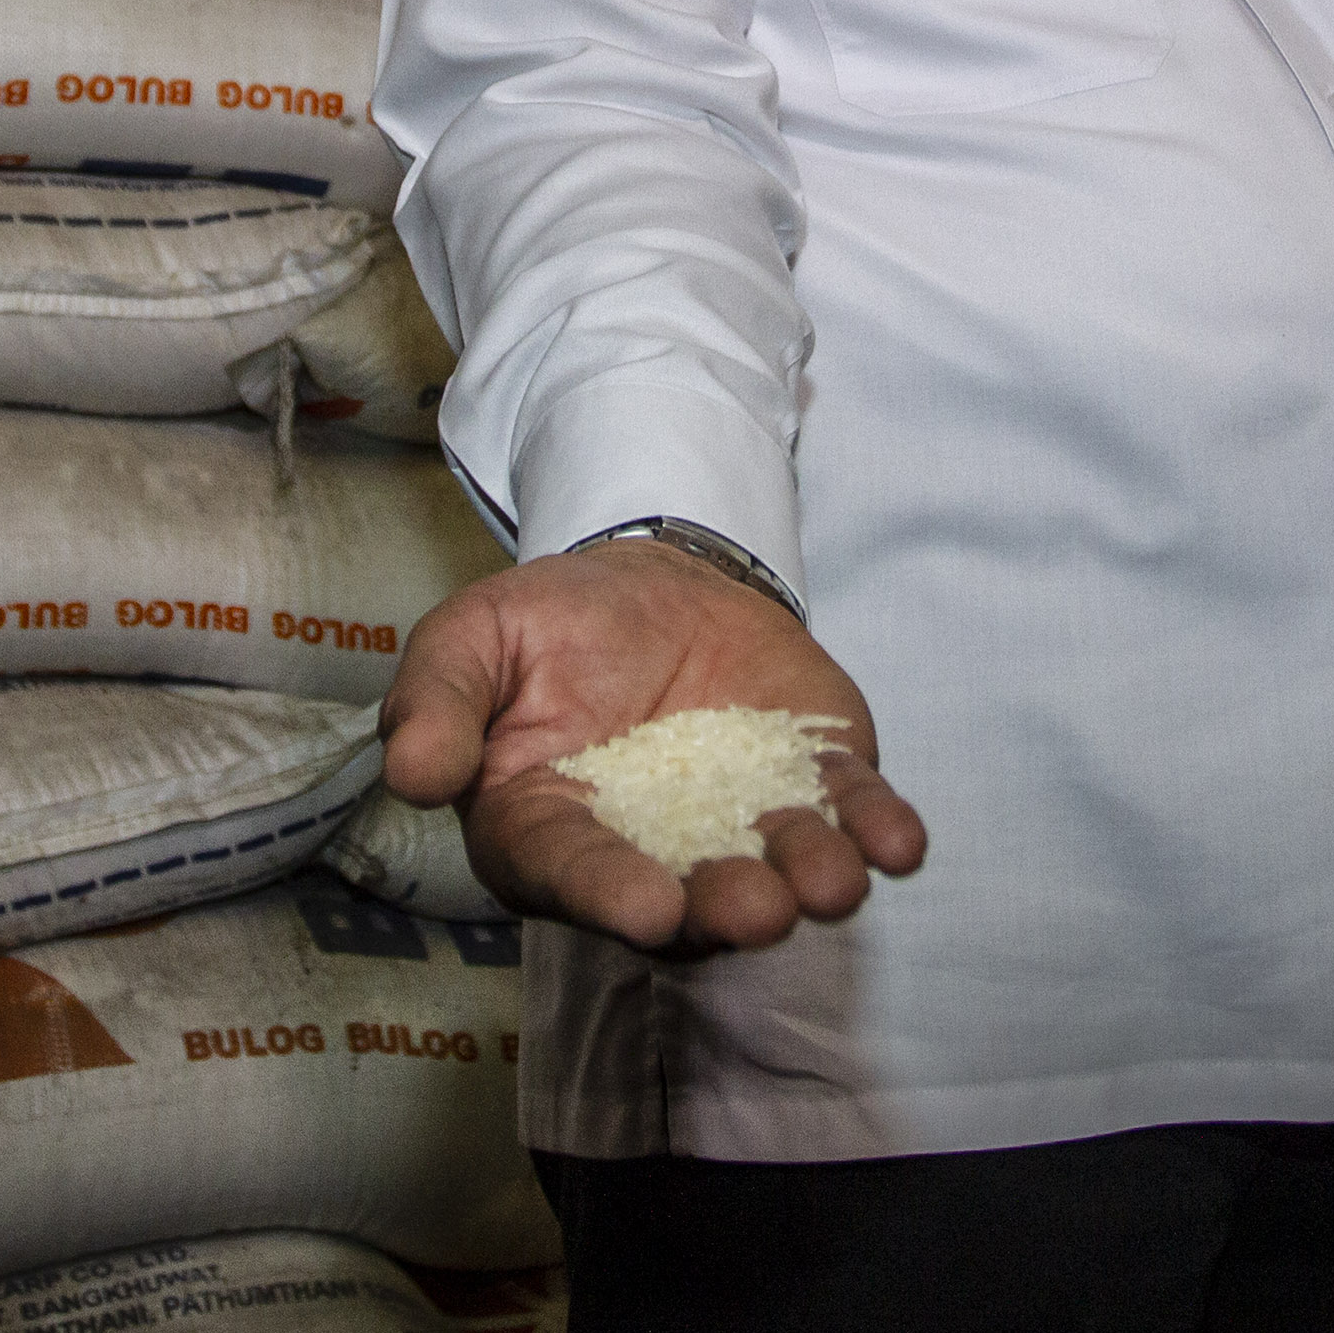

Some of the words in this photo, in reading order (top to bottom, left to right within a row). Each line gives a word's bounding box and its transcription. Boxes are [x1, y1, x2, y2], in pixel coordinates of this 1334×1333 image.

[56, 73, 194, 107] BULOG
[216, 80, 344, 122] BULOG
[115, 599, 250, 635] BULOG
[271, 610, 399, 655] BULOG
[183, 1022, 327, 1064] BULOG
[345, 1022, 480, 1063] BULOG
